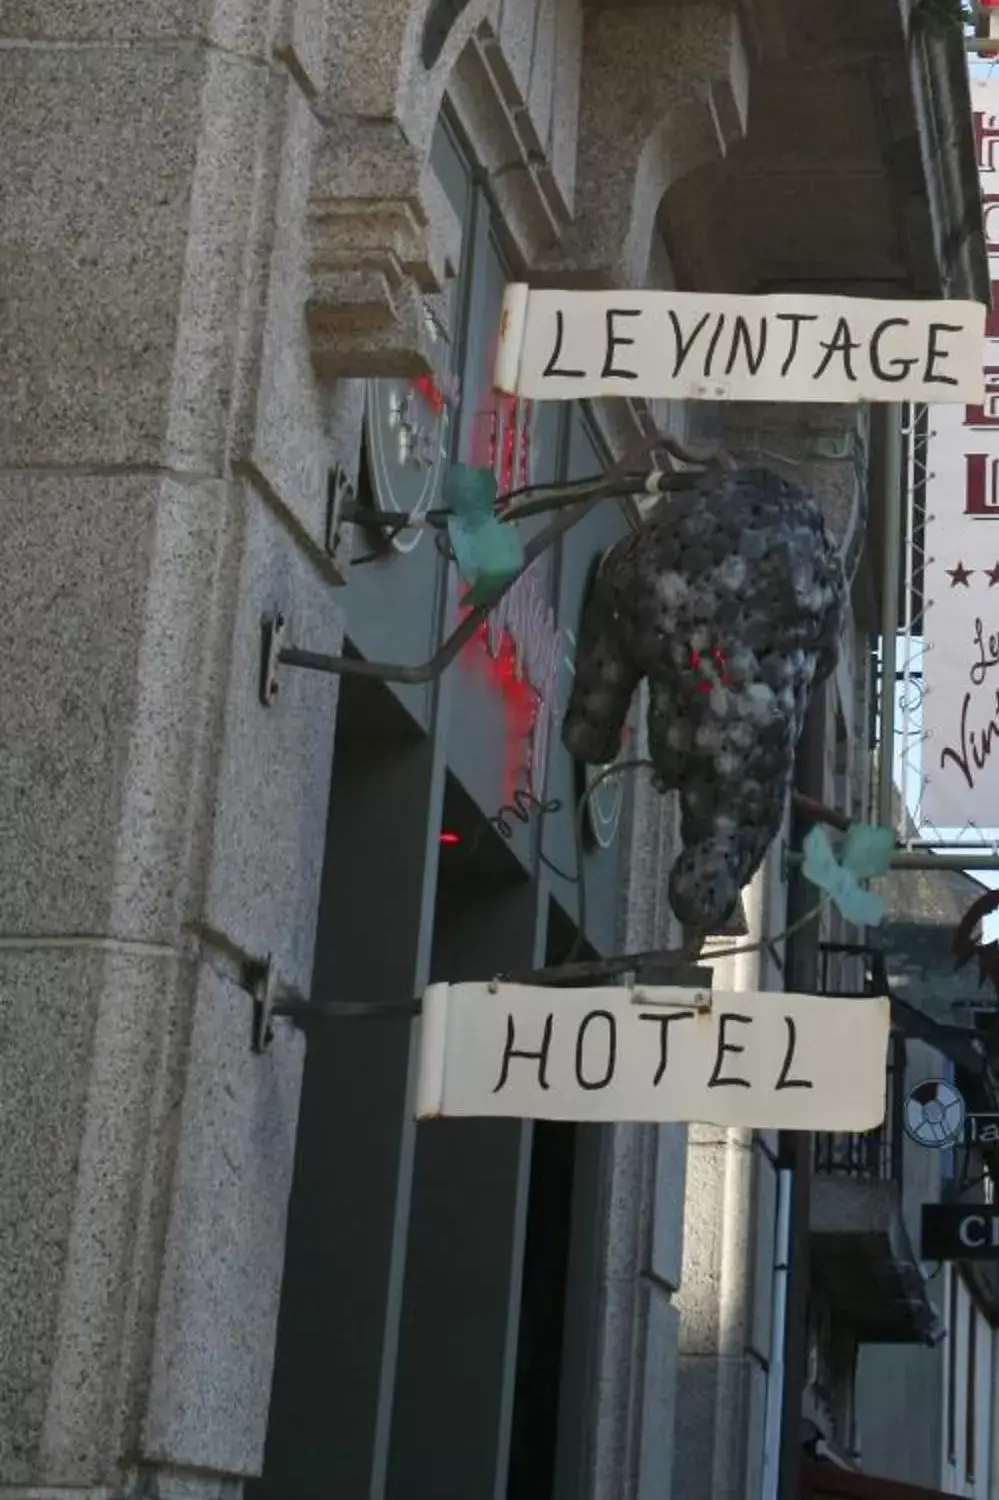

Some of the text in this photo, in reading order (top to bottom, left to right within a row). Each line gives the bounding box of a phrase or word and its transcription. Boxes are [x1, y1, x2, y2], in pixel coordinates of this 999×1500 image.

[542, 308, 965, 387] LE VINTAGE
[491, 1011, 815, 1093] HOTEL
